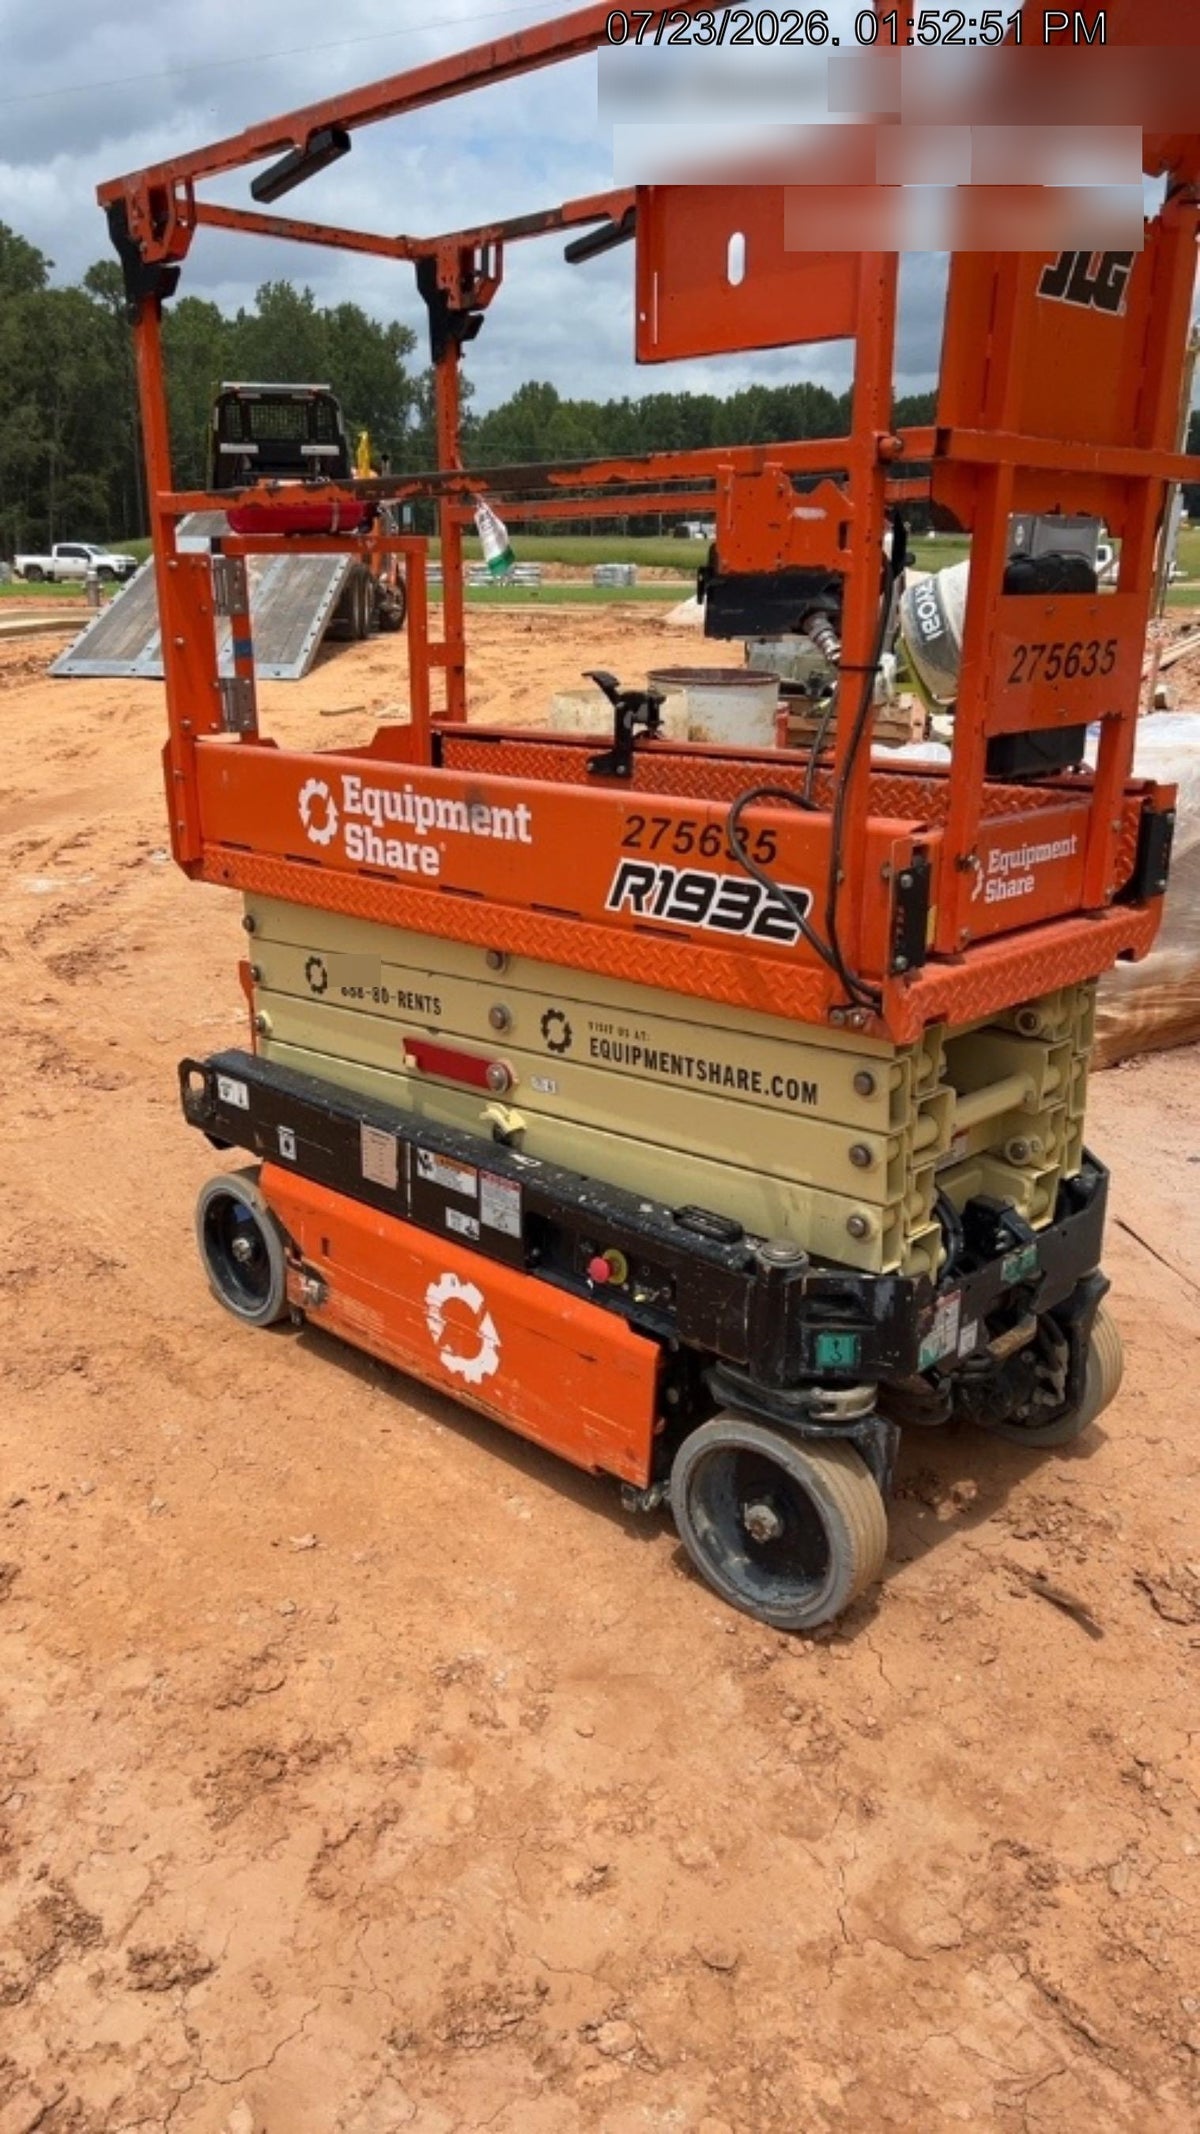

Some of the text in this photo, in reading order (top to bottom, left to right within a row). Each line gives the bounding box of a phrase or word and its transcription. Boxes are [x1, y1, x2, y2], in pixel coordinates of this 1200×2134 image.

[1036, 251, 1137, 316] JLG
[1008, 638, 1117, 685] 275635
[341, 774, 532, 845] Equipment
[344, 826, 441, 877] Share
[622, 815, 777, 864] 275635
[988, 836, 1078, 875] Equipment
[605, 857, 813, 946] R1932
[984, 874, 1035, 904] Share
[589, 1037, 819, 1105] EQUIPMENTSHARE.COM
